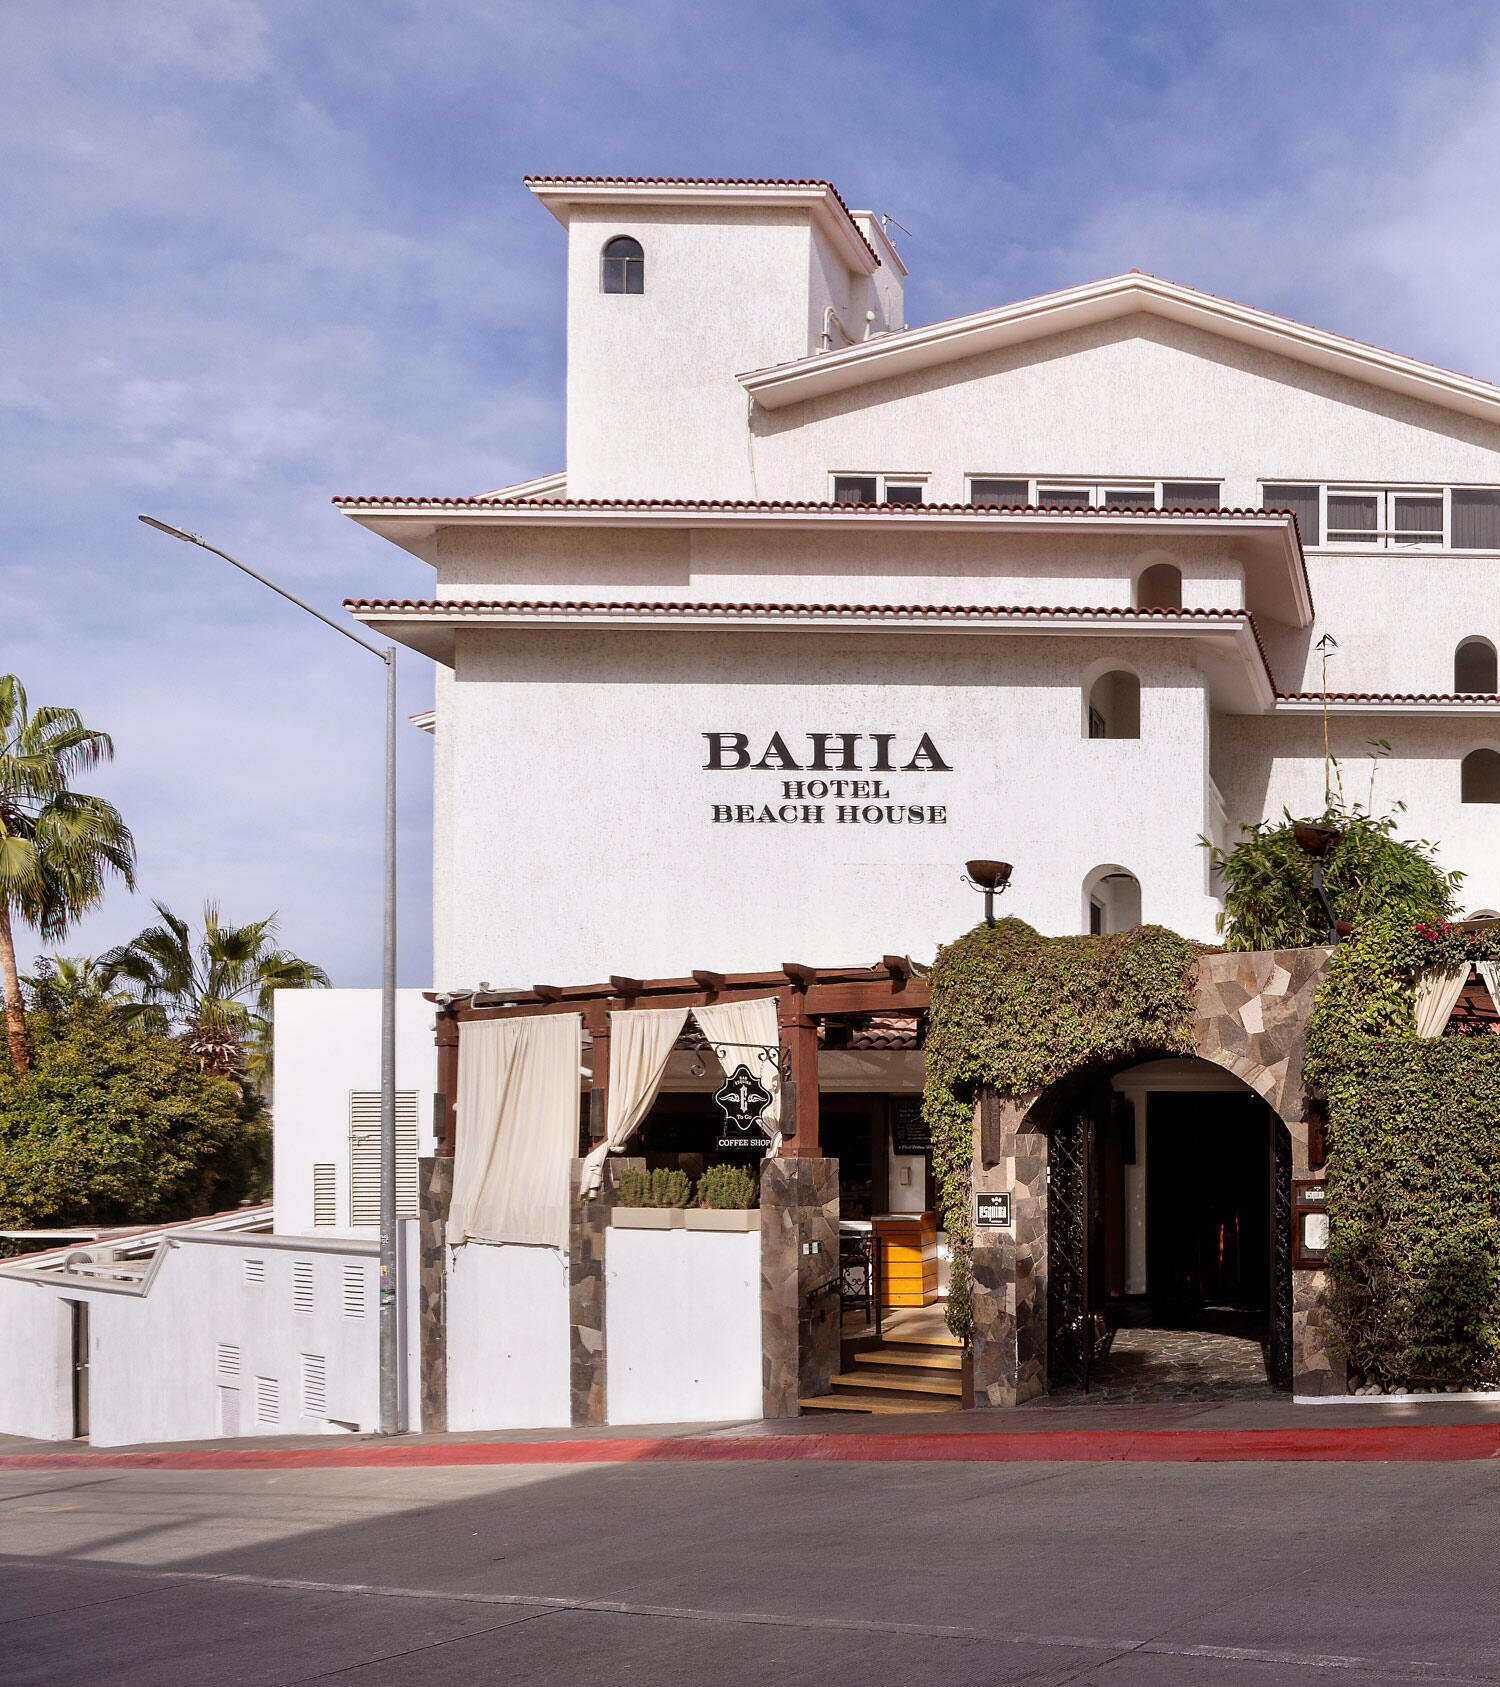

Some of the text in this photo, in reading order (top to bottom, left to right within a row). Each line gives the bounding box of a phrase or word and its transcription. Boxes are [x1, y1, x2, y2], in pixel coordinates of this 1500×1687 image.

[701, 731, 954, 772] BAHIA
[781, 779, 890, 800] HOTEL
[711, 804, 947, 824] BEACH HOUSE
[718, 1139, 771, 1147] COFFEE SHOP
